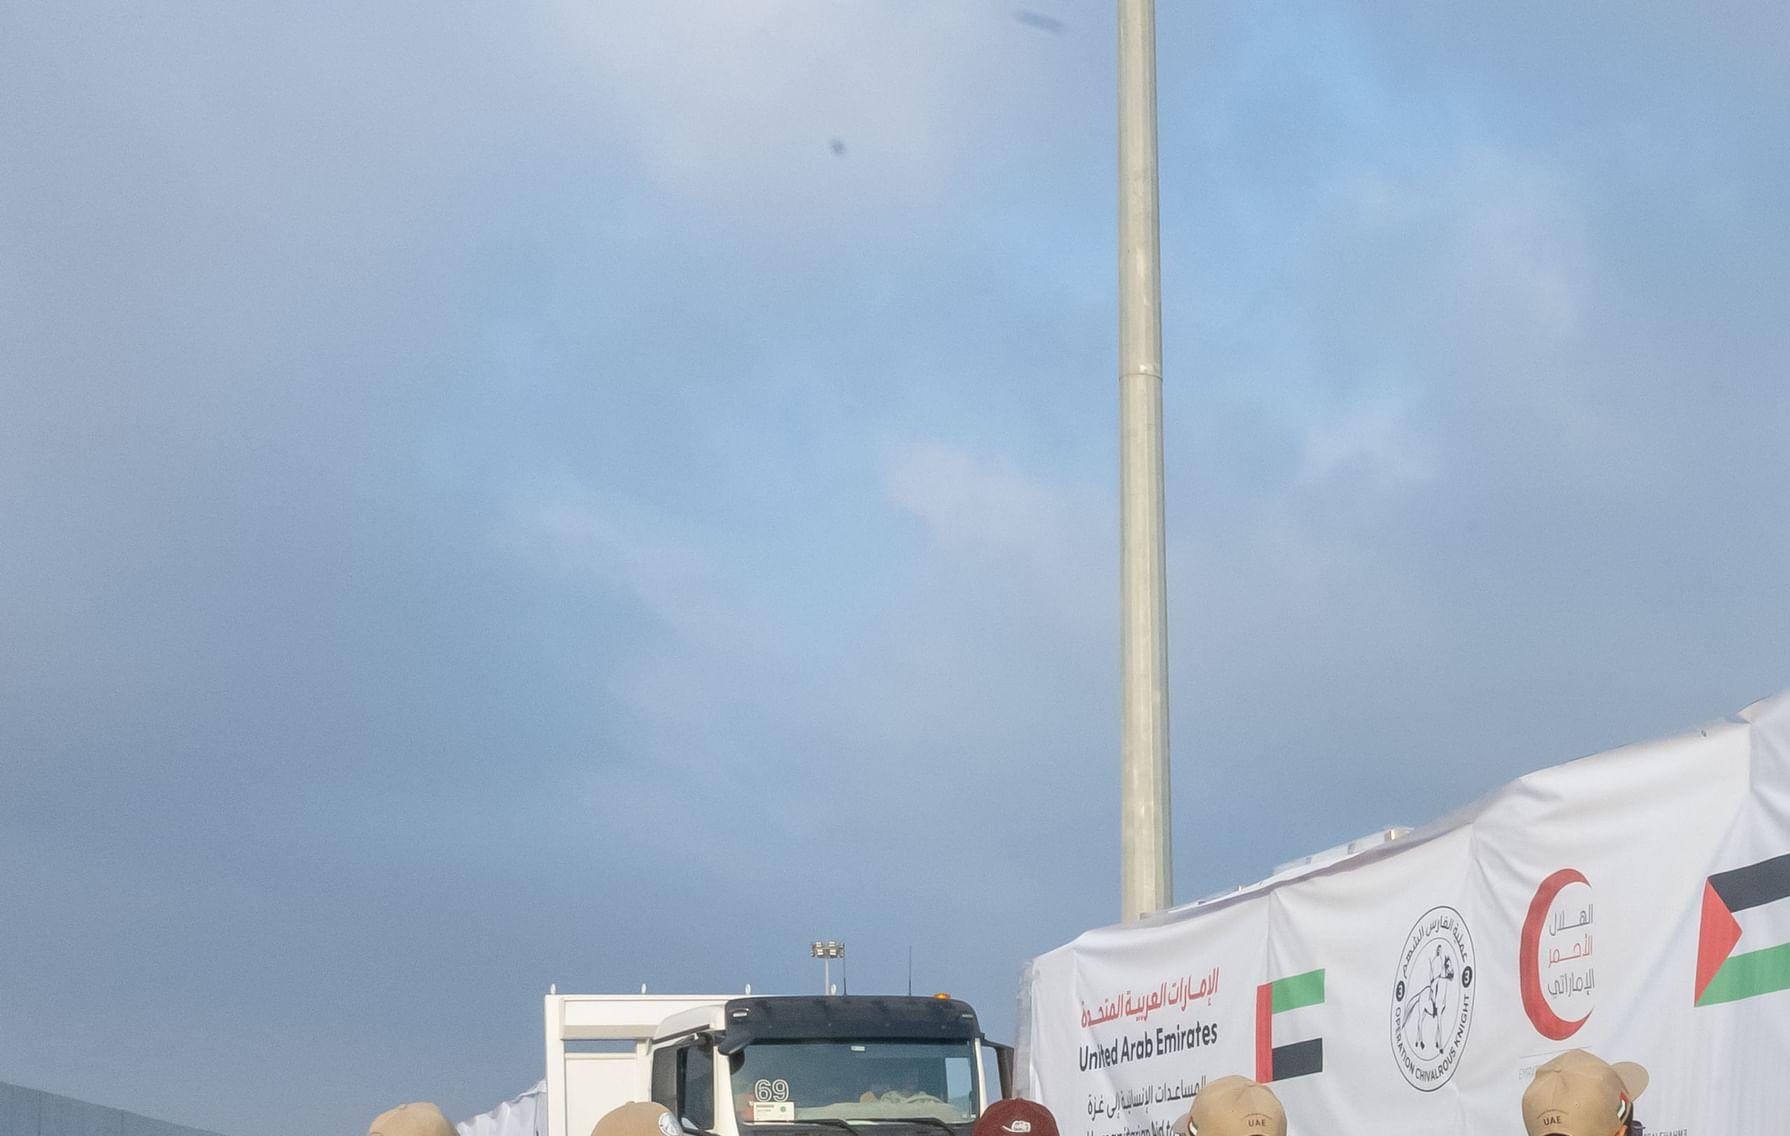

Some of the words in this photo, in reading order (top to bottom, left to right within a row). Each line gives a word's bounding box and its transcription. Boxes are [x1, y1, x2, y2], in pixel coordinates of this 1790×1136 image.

[1550, 904, 1594, 936] الهلال
[1167, 967, 1220, 1012] الإمارات
[1079, 1037, 1119, 1072] United
[1120, 1031, 1154, 1064] Arab
[1155, 1020, 1219, 1056] Emirates
[754, 1078, 790, 1103] 69
[1247, 1118, 1267, 1128] UAE
[1543, 1114, 1562, 1126] UAE
